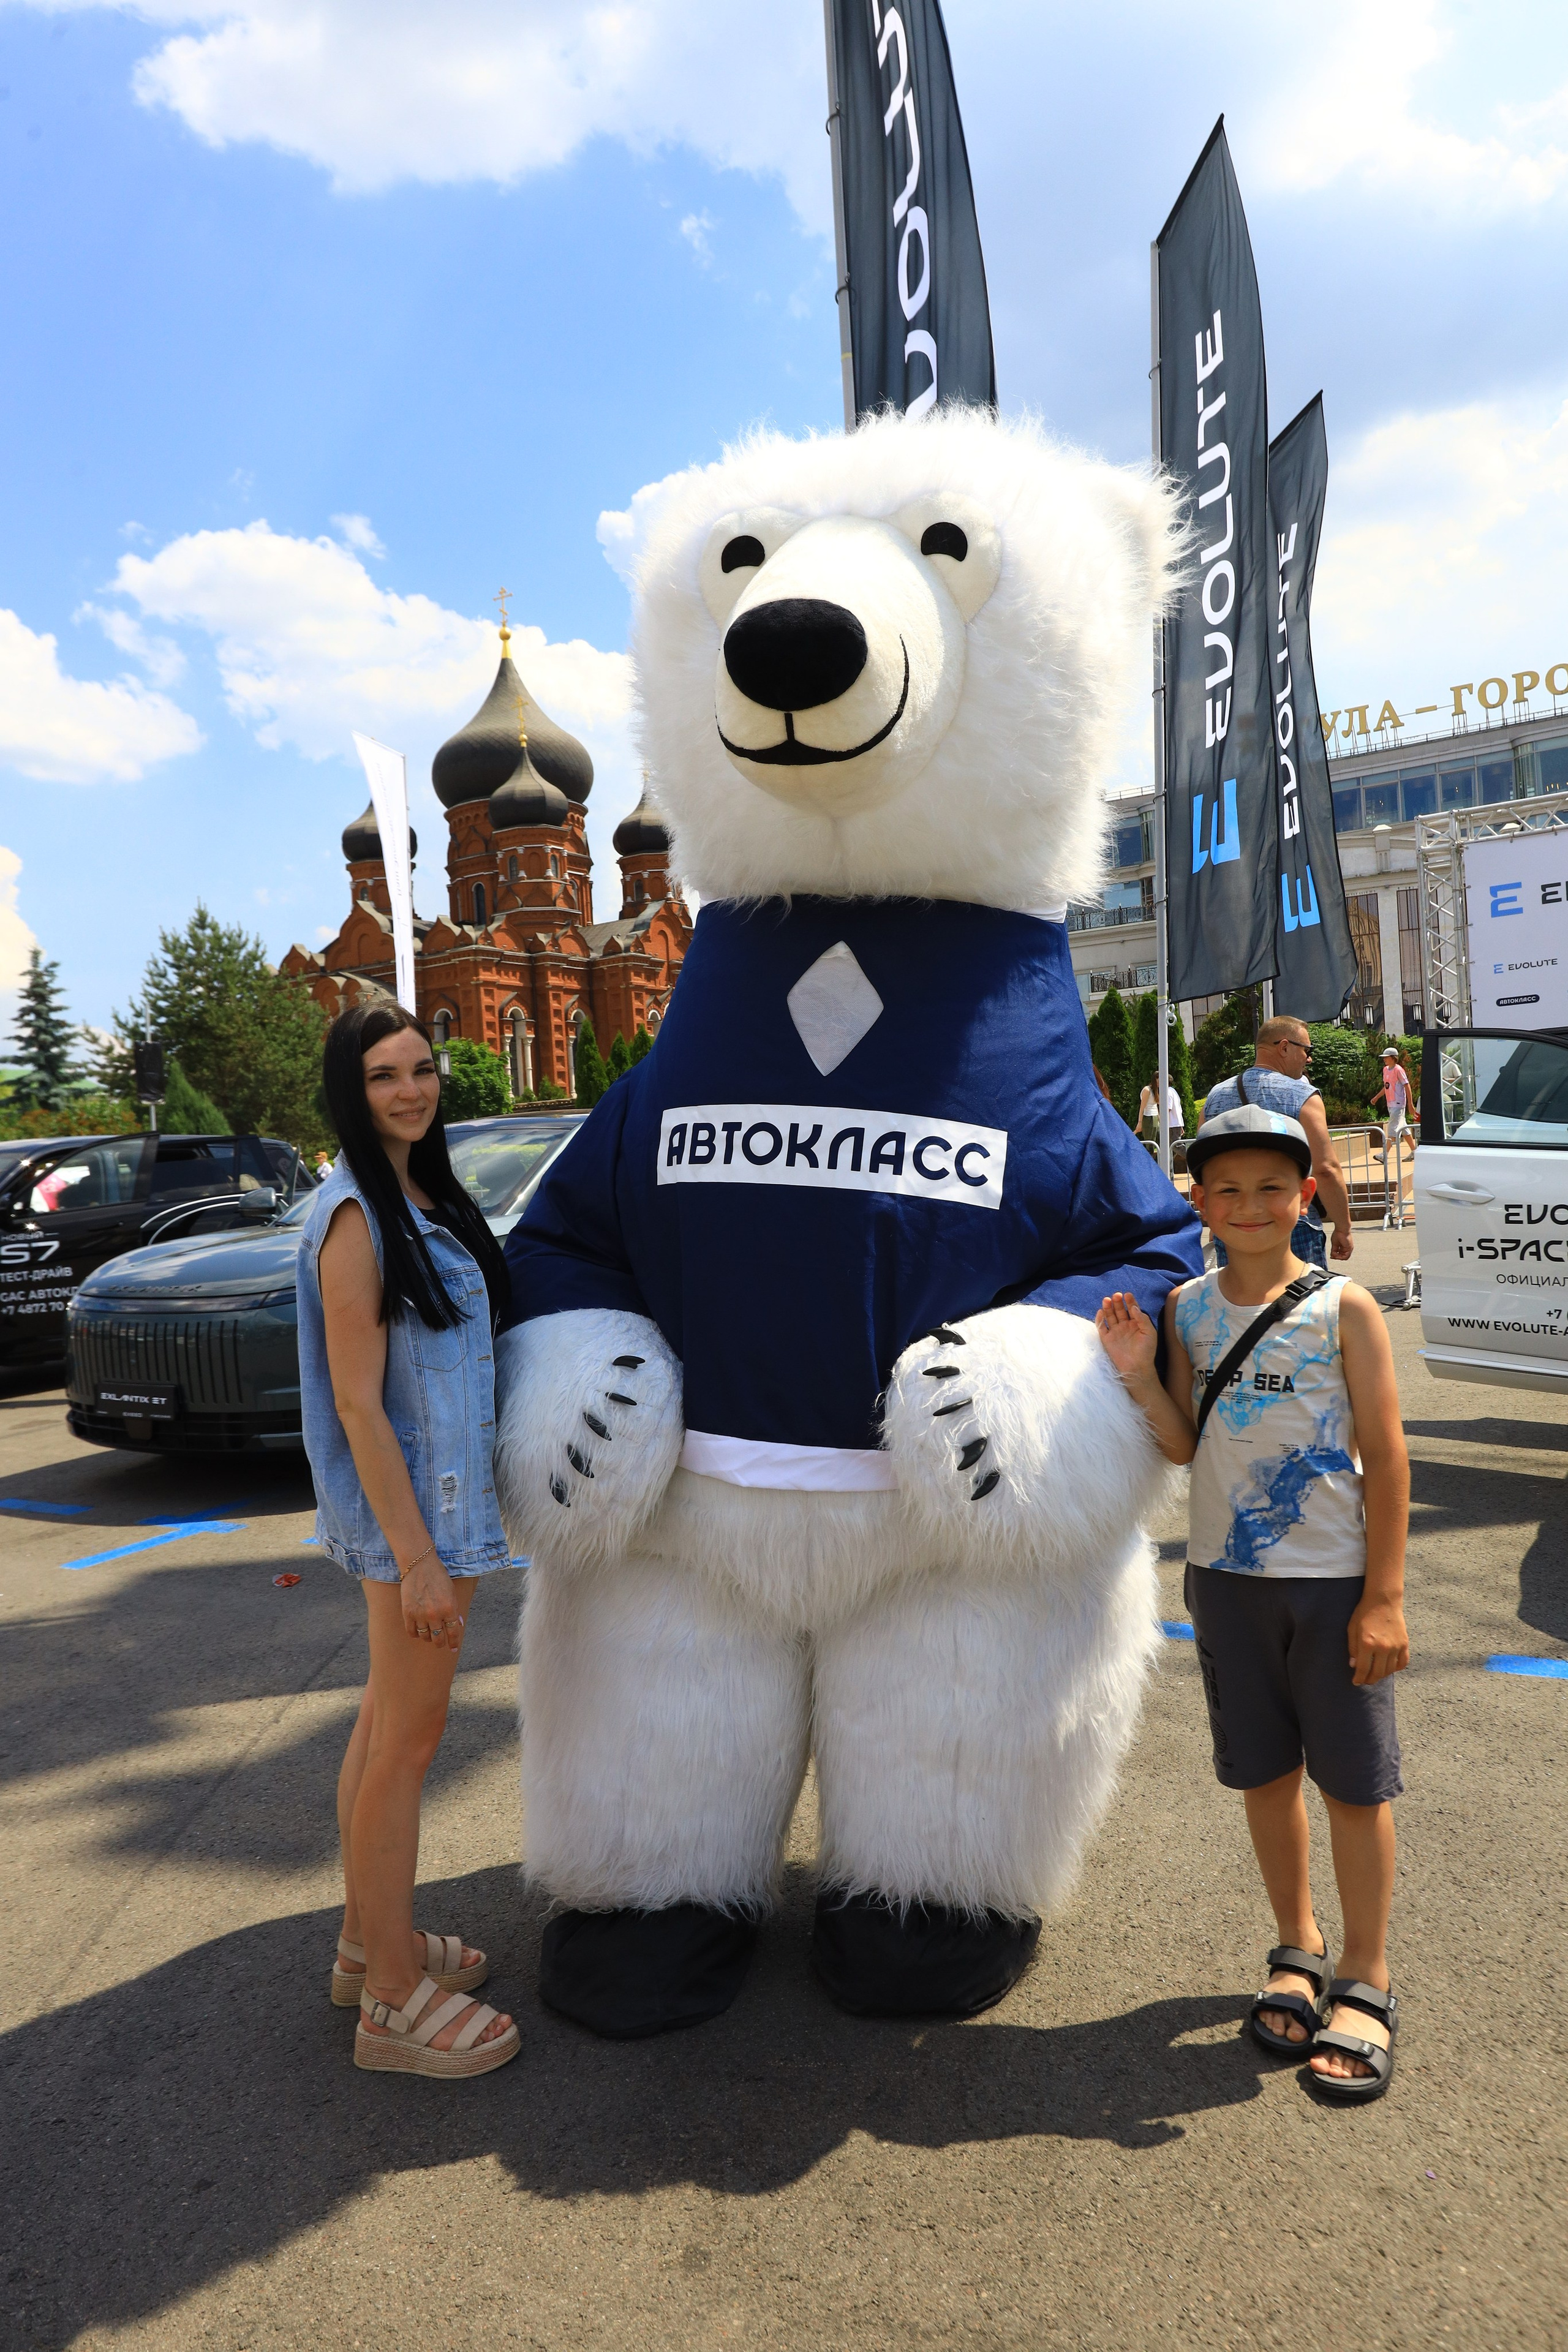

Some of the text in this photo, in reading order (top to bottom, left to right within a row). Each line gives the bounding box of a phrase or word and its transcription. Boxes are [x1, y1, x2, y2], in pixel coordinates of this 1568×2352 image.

[1195, 309, 1235, 748] EVOLUTE
[1276, 522, 1300, 840] EVOLUTE
[1540, 880, 1568, 905] E
[1508, 958, 1558, 971] EVOLUTE
[1499, 995, 1536, 1005] АВТОКЛАСС
[667, 1121, 990, 1187] АВТОКЛАСС
[1504, 1204, 1568, 1225] EVO
[0, 1240, 60, 1264] S7
[1458, 1238, 1568, 1262] i-SPAC
[0, 1265, 73, 1283] ТЕСТ-ДРАЙВ
[0, 1291, 26, 1302] GAC
[17, 1302, 48, 1314] 4872
[49, 1301, 65, 1311] 70
[1546, 1309, 1562, 1319] +7
[1447, 1317, 1490, 1330] WWW
[1197, 1369, 1295, 1393] DEP SEA
[100, 1392, 150, 1404] EXLANTIX
